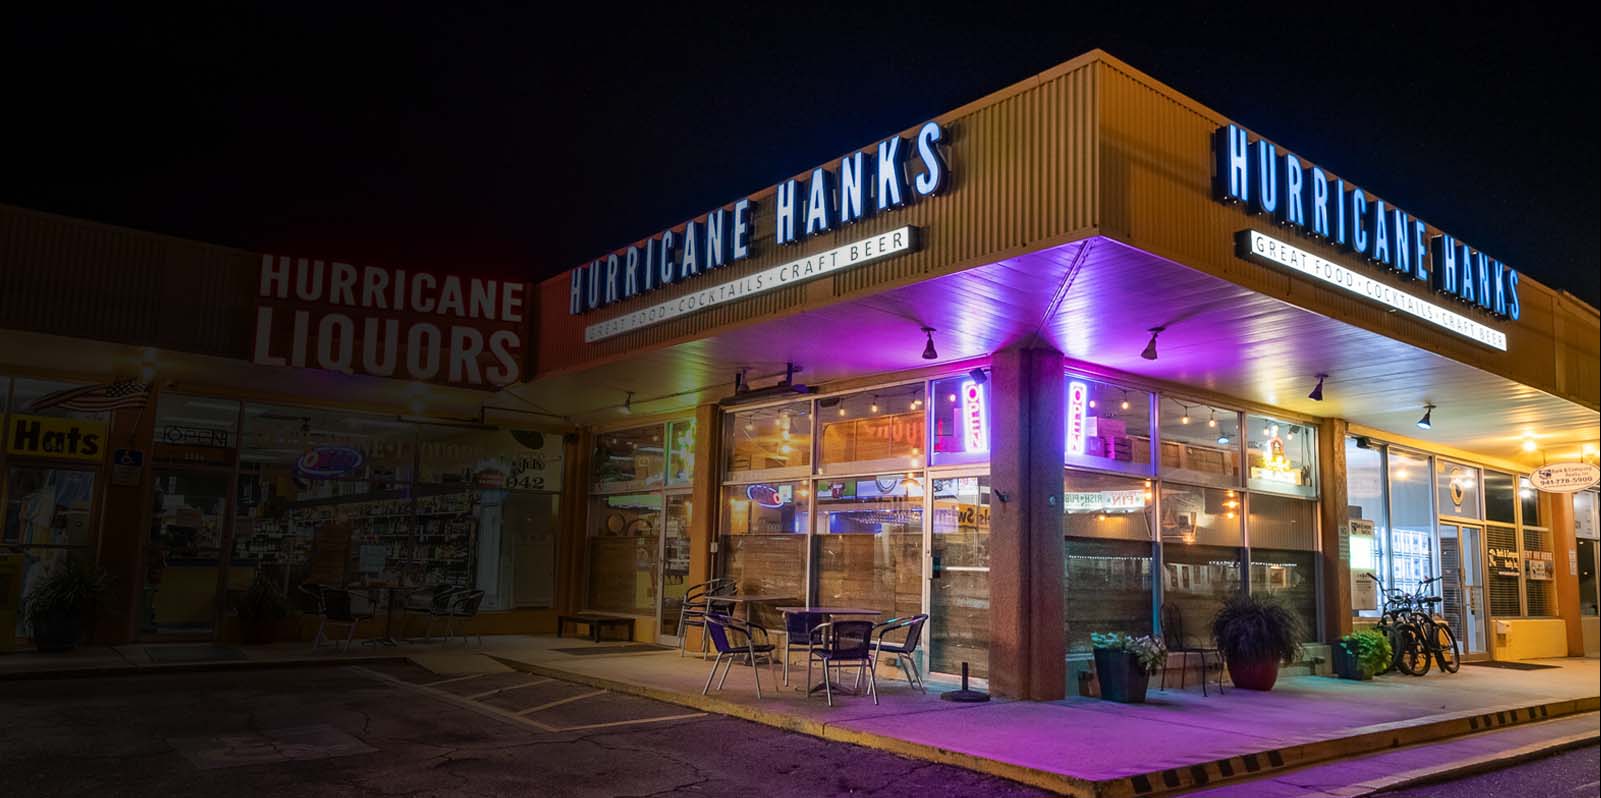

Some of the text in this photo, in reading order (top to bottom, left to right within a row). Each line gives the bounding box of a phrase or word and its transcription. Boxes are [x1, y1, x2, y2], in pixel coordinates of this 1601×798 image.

[570, 122, 941, 315] HURRICANE HANKS
[1227, 123, 1520, 321] HURRICANE HANKS
[258, 253, 525, 323] HURRICANE
[631, 306, 665, 326] FOOD
[678, 275, 764, 312] COCKTAILS
[779, 251, 840, 282] CRAFT
[849, 232, 904, 262] BEER
[1256, 236, 1504, 346] GREAT FOOD COCKTAILS CRAFT BEER
[253, 305, 521, 386] LIQUORS
[15, 419, 99, 456] Hats
[966, 384, 982, 450] OPEN
[1071, 384, 1084, 452] OPEN
